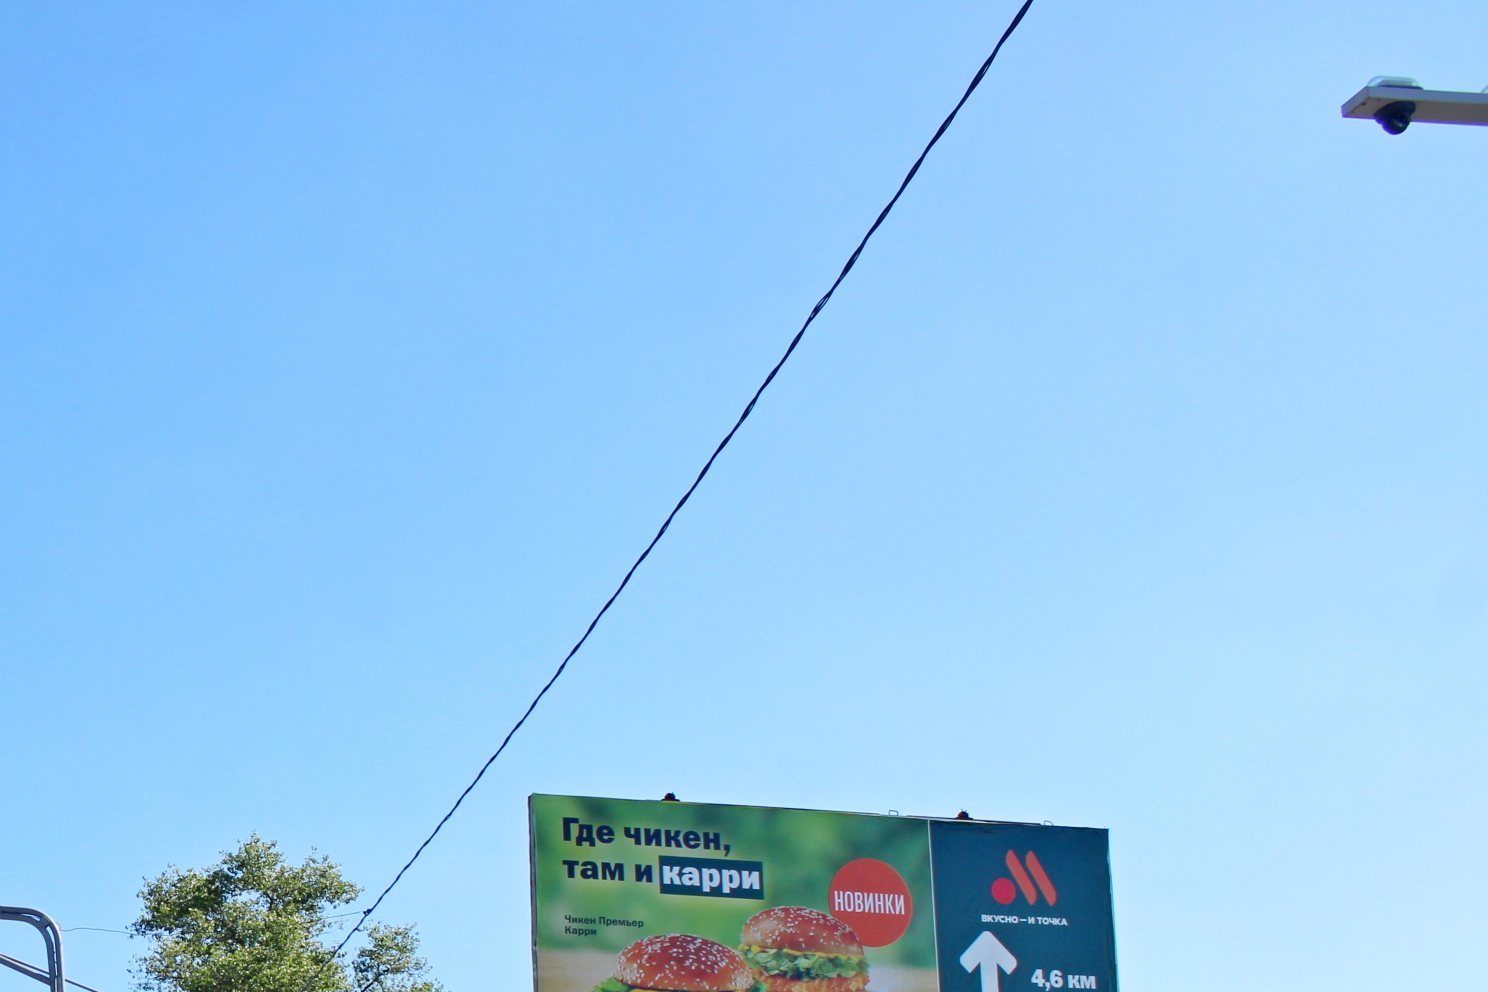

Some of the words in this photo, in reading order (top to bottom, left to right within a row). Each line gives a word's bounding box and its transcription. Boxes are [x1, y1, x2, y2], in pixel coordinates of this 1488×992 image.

[563, 817, 615, 847] Где
[624, 827, 731, 856] чикен,
[562, 860, 625, 882] там
[635, 864, 653, 883] и
[662, 864, 760, 893] карри
[834, 891, 905, 915] НОВИНКИ
[565, 915, 597, 925] Чикен
[599, 916, 644, 928] Премьер
[565, 926, 597, 936] Карри
[981, 914, 1018, 924] ВКУСНО
[1028, 916, 1035, 924] И
[1037, 917, 1068, 926] ТОЧКА
[1031, 968, 1063, 991] 4,6
[1067, 975, 1096, 989] км
